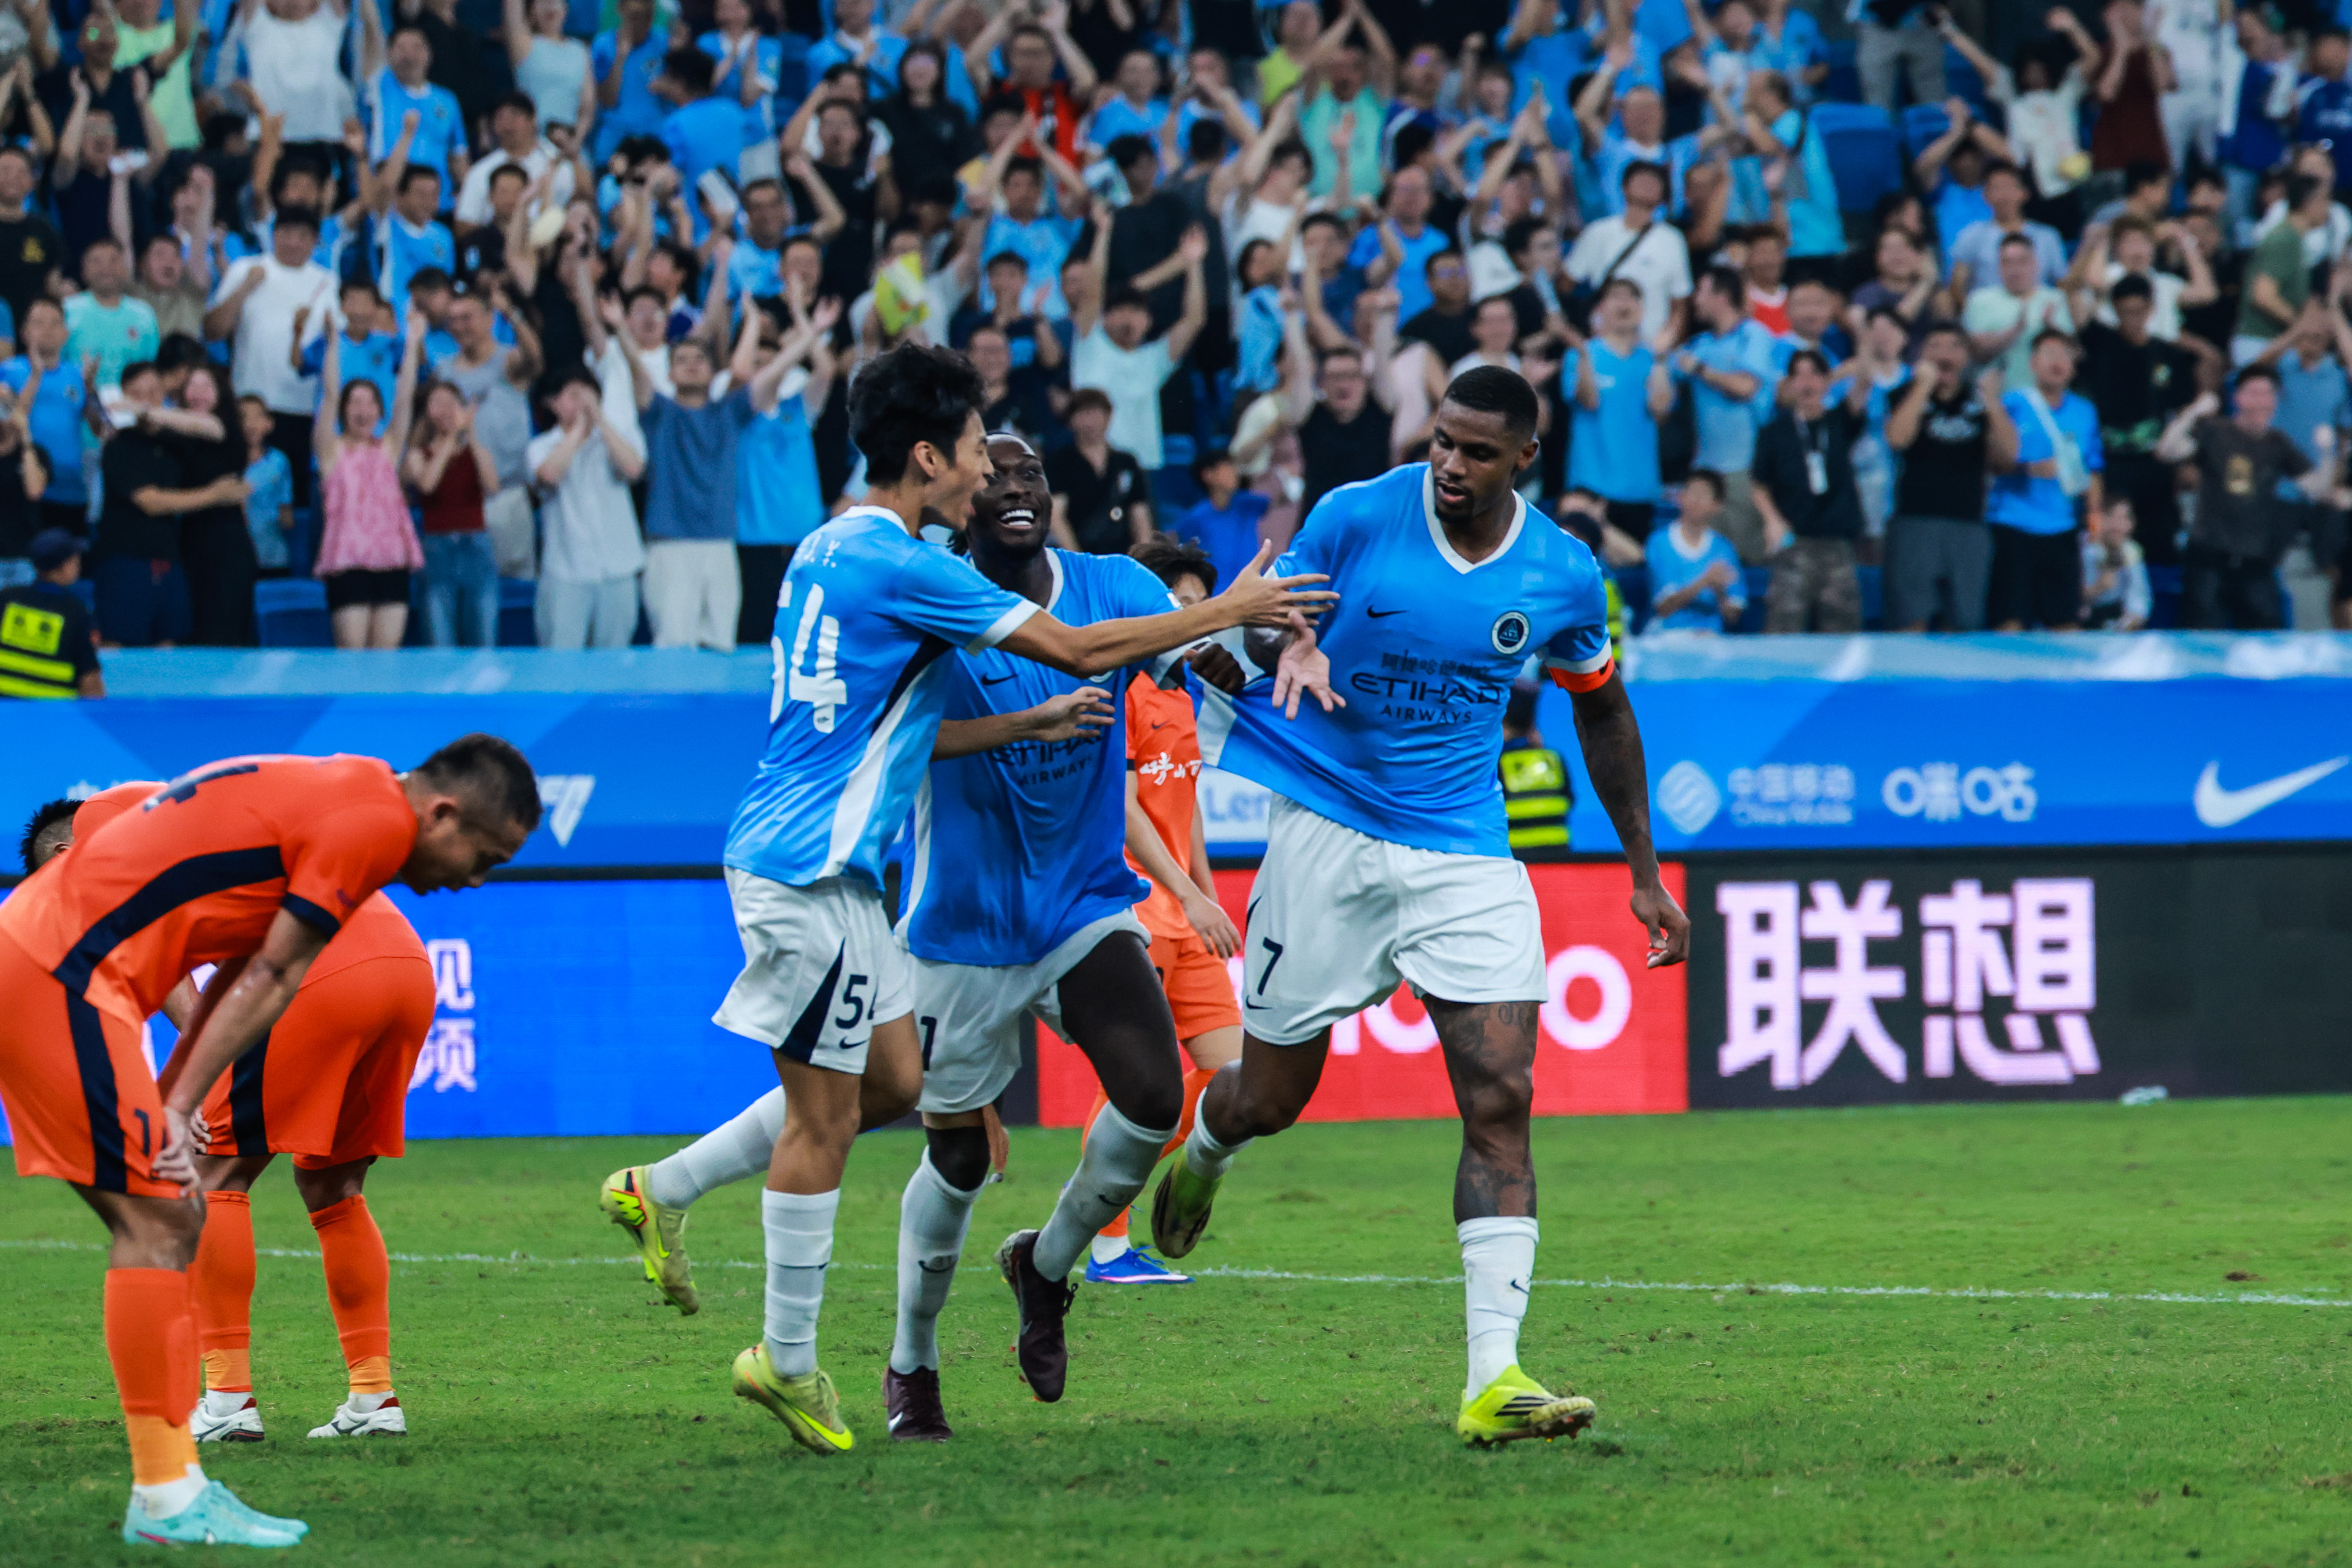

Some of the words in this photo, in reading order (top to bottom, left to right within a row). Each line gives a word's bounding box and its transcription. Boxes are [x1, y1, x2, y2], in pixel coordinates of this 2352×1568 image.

[1381, 704, 1472, 724] AIRWAYS
[1263, 937, 1283, 996] 7
[1716, 877, 2101, 1091] 联想
